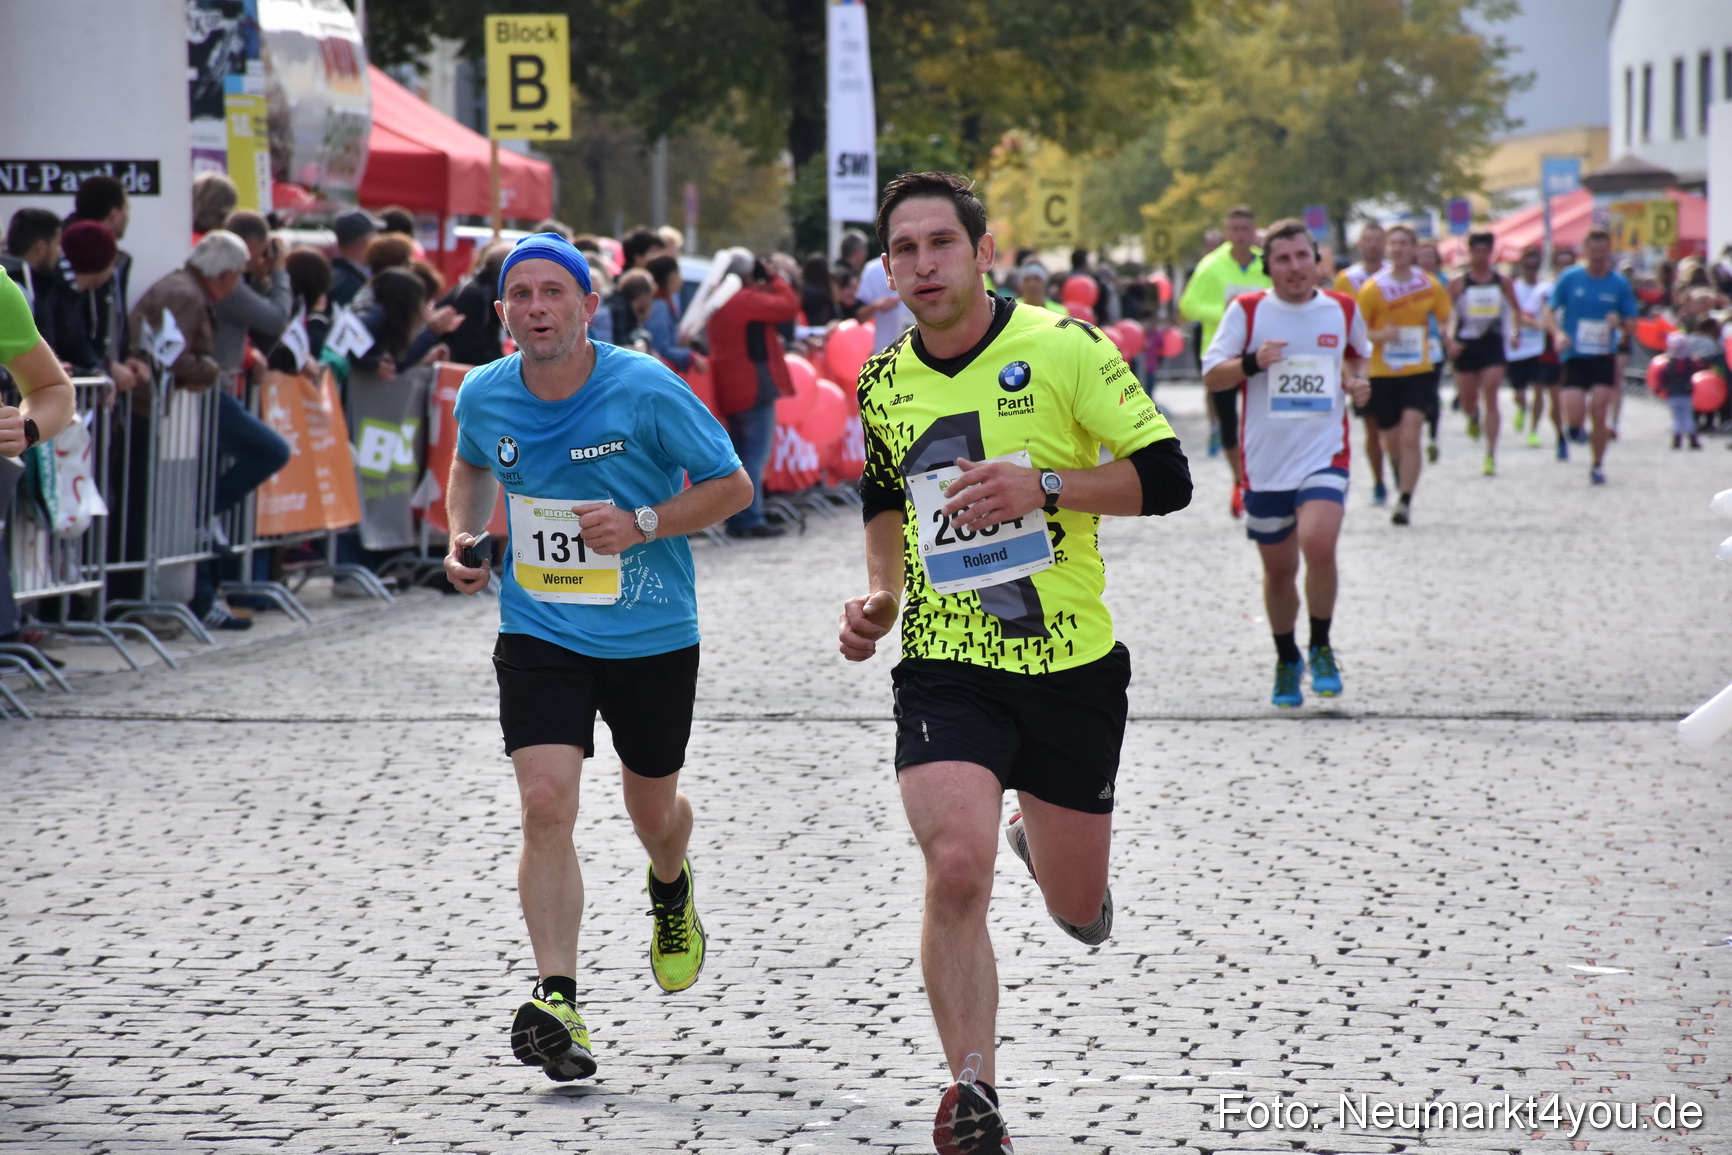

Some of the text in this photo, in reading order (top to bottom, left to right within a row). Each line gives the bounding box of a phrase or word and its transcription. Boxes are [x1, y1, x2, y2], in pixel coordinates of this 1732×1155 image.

[496, 21, 558, 43] Block
[509, 54, 548, 111] B
[1044, 195, 1066, 227] C
[1279, 374, 1325, 394] 2362
[997, 394, 1034, 411] Partl
[998, 407, 1035, 417] Neumarkt
[1133, 420, 1144, 430] 100
[570, 440, 625, 461] BOCK
[517, 551, 522, 559] C
[532, 530, 586, 563] 131
[962, 547, 1009, 569] Roland
[542, 573, 584, 585] Werner
[641, 566, 650, 580] 2017
